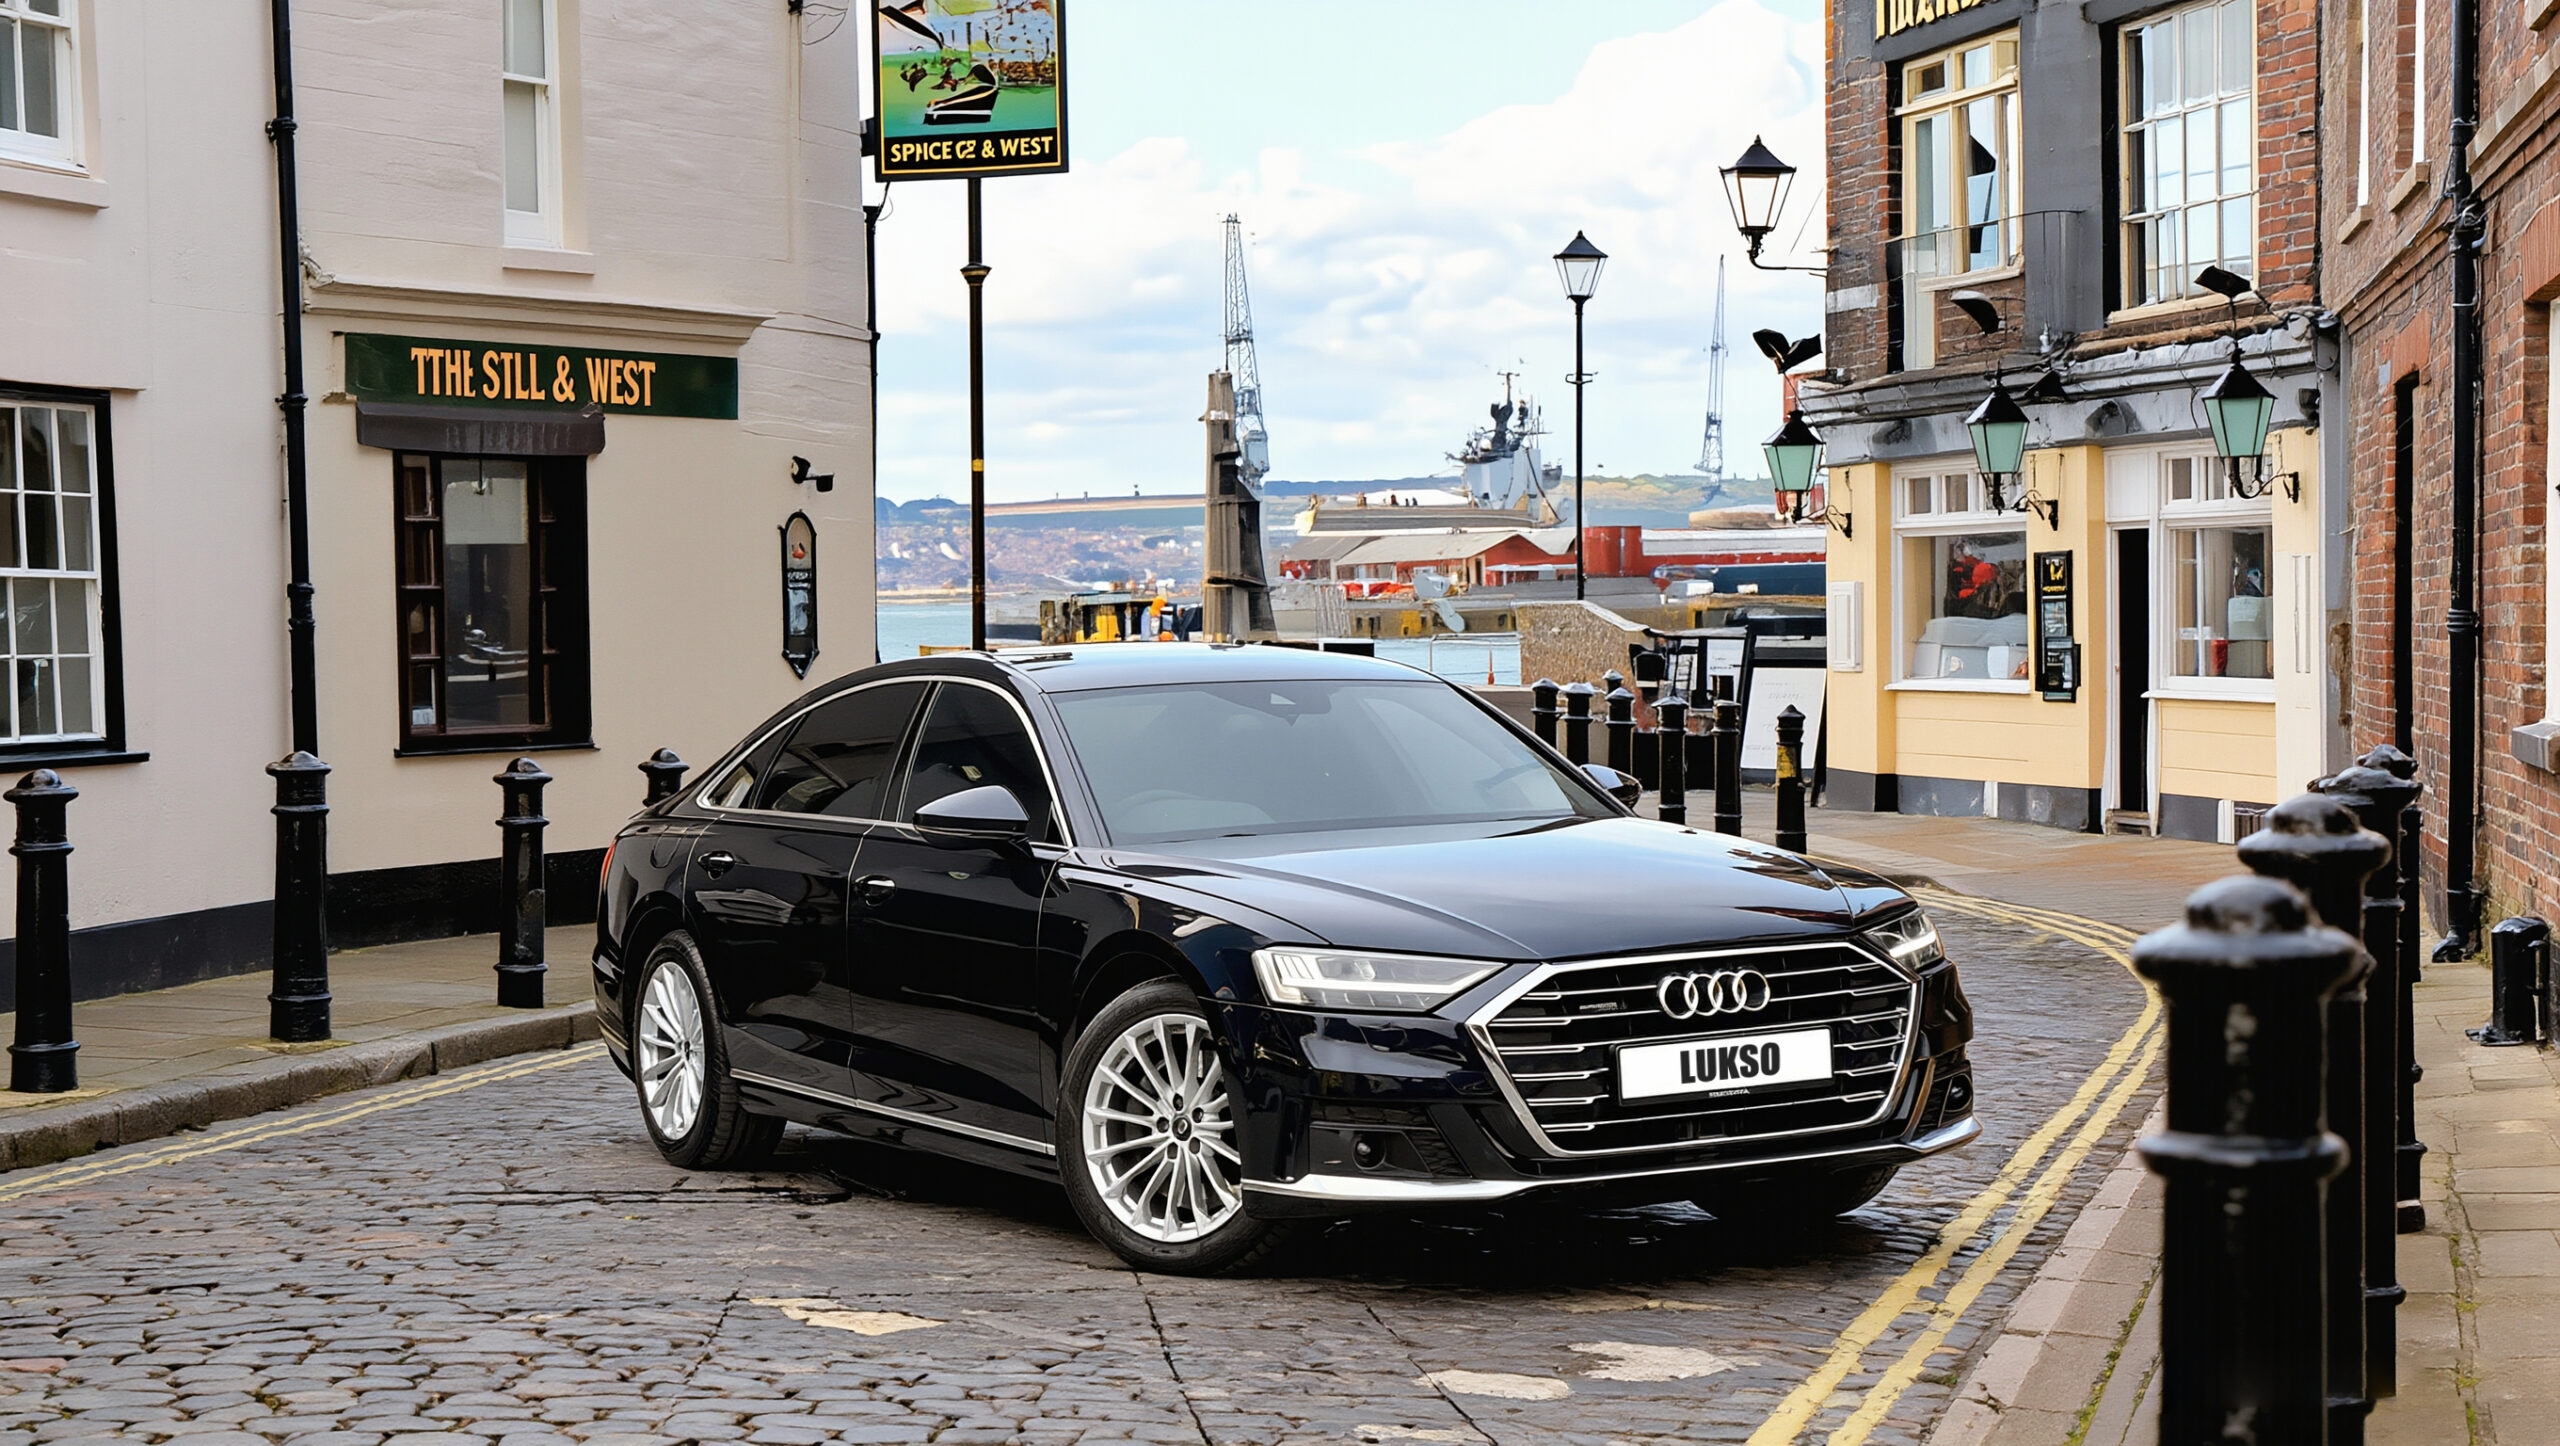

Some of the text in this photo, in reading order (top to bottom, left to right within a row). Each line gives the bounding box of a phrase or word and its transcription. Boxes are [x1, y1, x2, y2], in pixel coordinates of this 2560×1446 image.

[981, 139, 996, 159] &
[999, 135, 1053, 157] WEST
[552, 355, 576, 403] &
[585, 357, 656, 407] WEST
[1680, 1042, 1780, 1084] LUKSO
